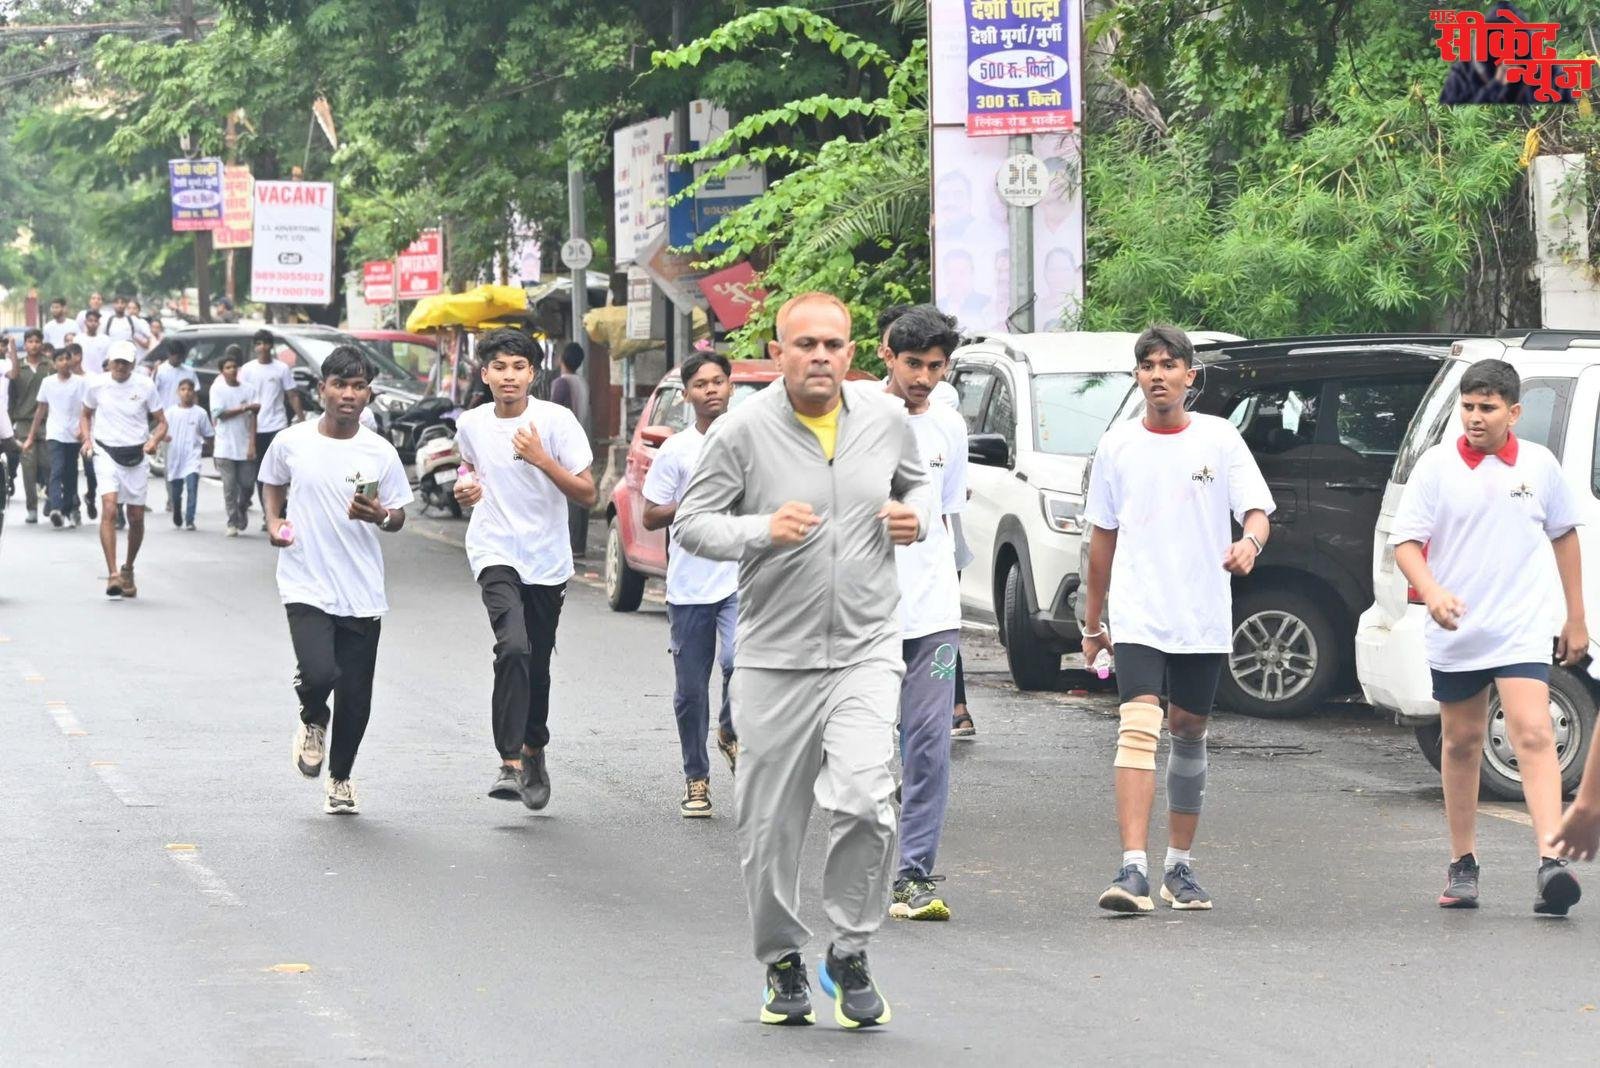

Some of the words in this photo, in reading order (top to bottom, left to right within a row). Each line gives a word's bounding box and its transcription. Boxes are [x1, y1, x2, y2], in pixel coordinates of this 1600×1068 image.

[971, 25, 998, 45] देशी
[980, 62, 1004, 79] 500
[1026, 56, 1055, 78] किलो
[976, 94, 1005, 109] 300
[1028, 89, 1062, 107] किलो
[257, 186, 327, 206] VACANT
[1027, 188, 1042, 196] City
